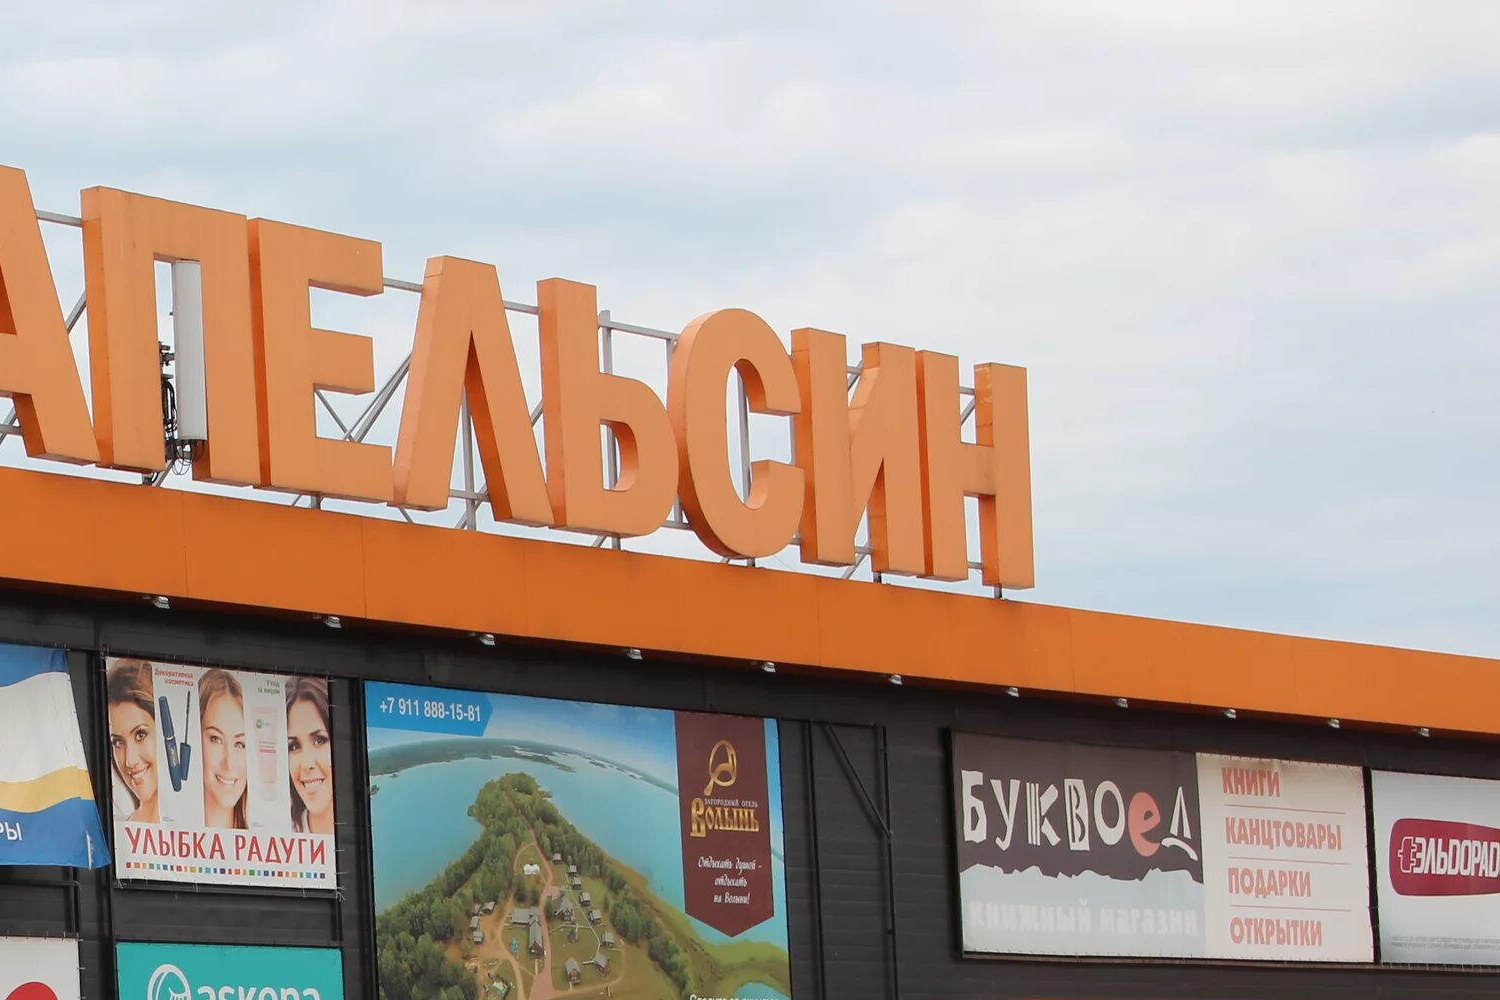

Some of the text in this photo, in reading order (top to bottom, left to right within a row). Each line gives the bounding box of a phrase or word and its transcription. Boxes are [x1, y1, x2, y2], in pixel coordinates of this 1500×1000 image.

[380, 698, 482, 722] +7 911 888-15-81
[1222, 767, 1281, 798] КНИГИ
[125, 827, 325, 865] УЛЫБКА РАДУГИ
[1225, 818, 1342, 851] КАНЦТОВАРЫ
[1228, 867, 1312, 899] ПОДАРКИ
[1229, 917, 1323, 946] ОТКРЫТКИ
